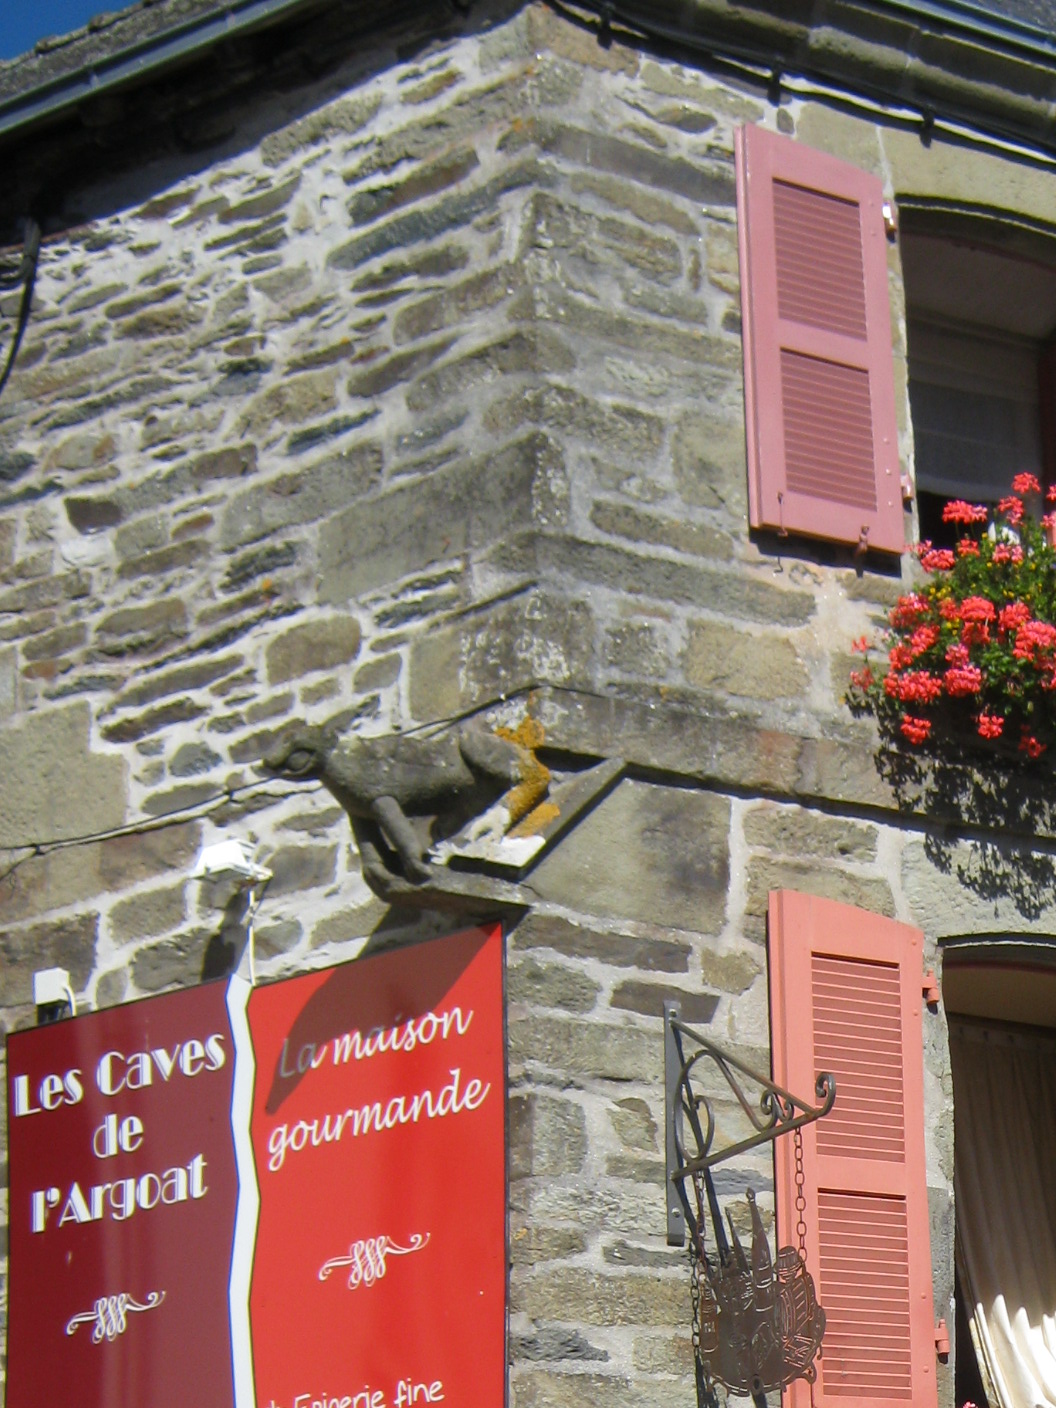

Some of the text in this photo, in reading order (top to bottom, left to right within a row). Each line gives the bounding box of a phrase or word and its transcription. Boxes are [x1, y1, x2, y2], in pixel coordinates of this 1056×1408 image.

[14, 1033, 226, 1117] Les Caves
[279, 1006, 475, 1079] La maison
[93, 1113, 145, 1159] de
[267, 1068, 492, 1173] gourmande
[31, 1153, 209, 1234] l'Argoat
